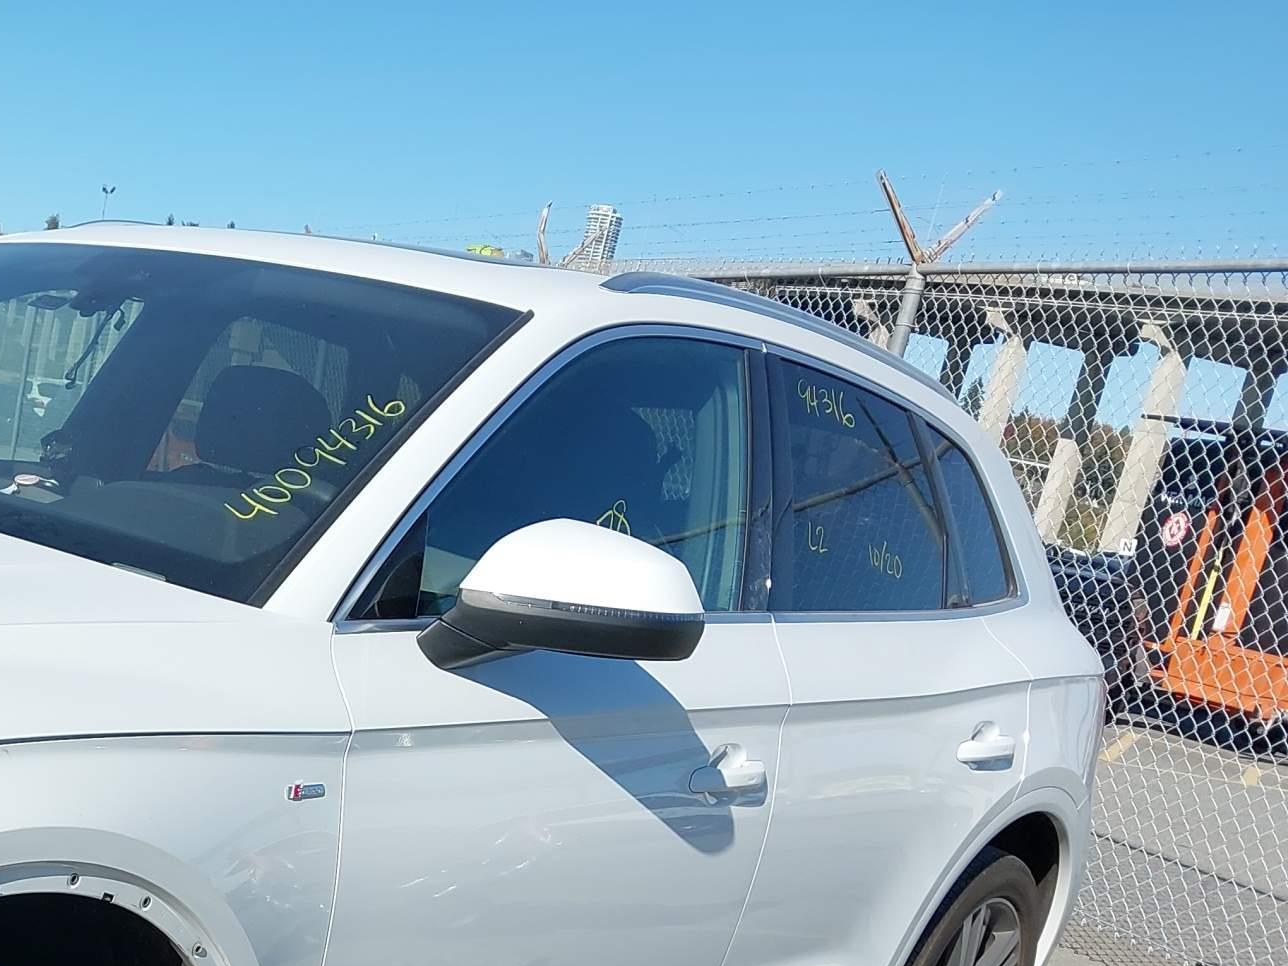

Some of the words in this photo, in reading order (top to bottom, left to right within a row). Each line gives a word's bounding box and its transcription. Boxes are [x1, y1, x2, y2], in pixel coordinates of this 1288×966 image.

[798, 378, 856, 428] 94316
[224, 394, 405, 520] 40094316
[868, 540, 903, 578] 10/20
